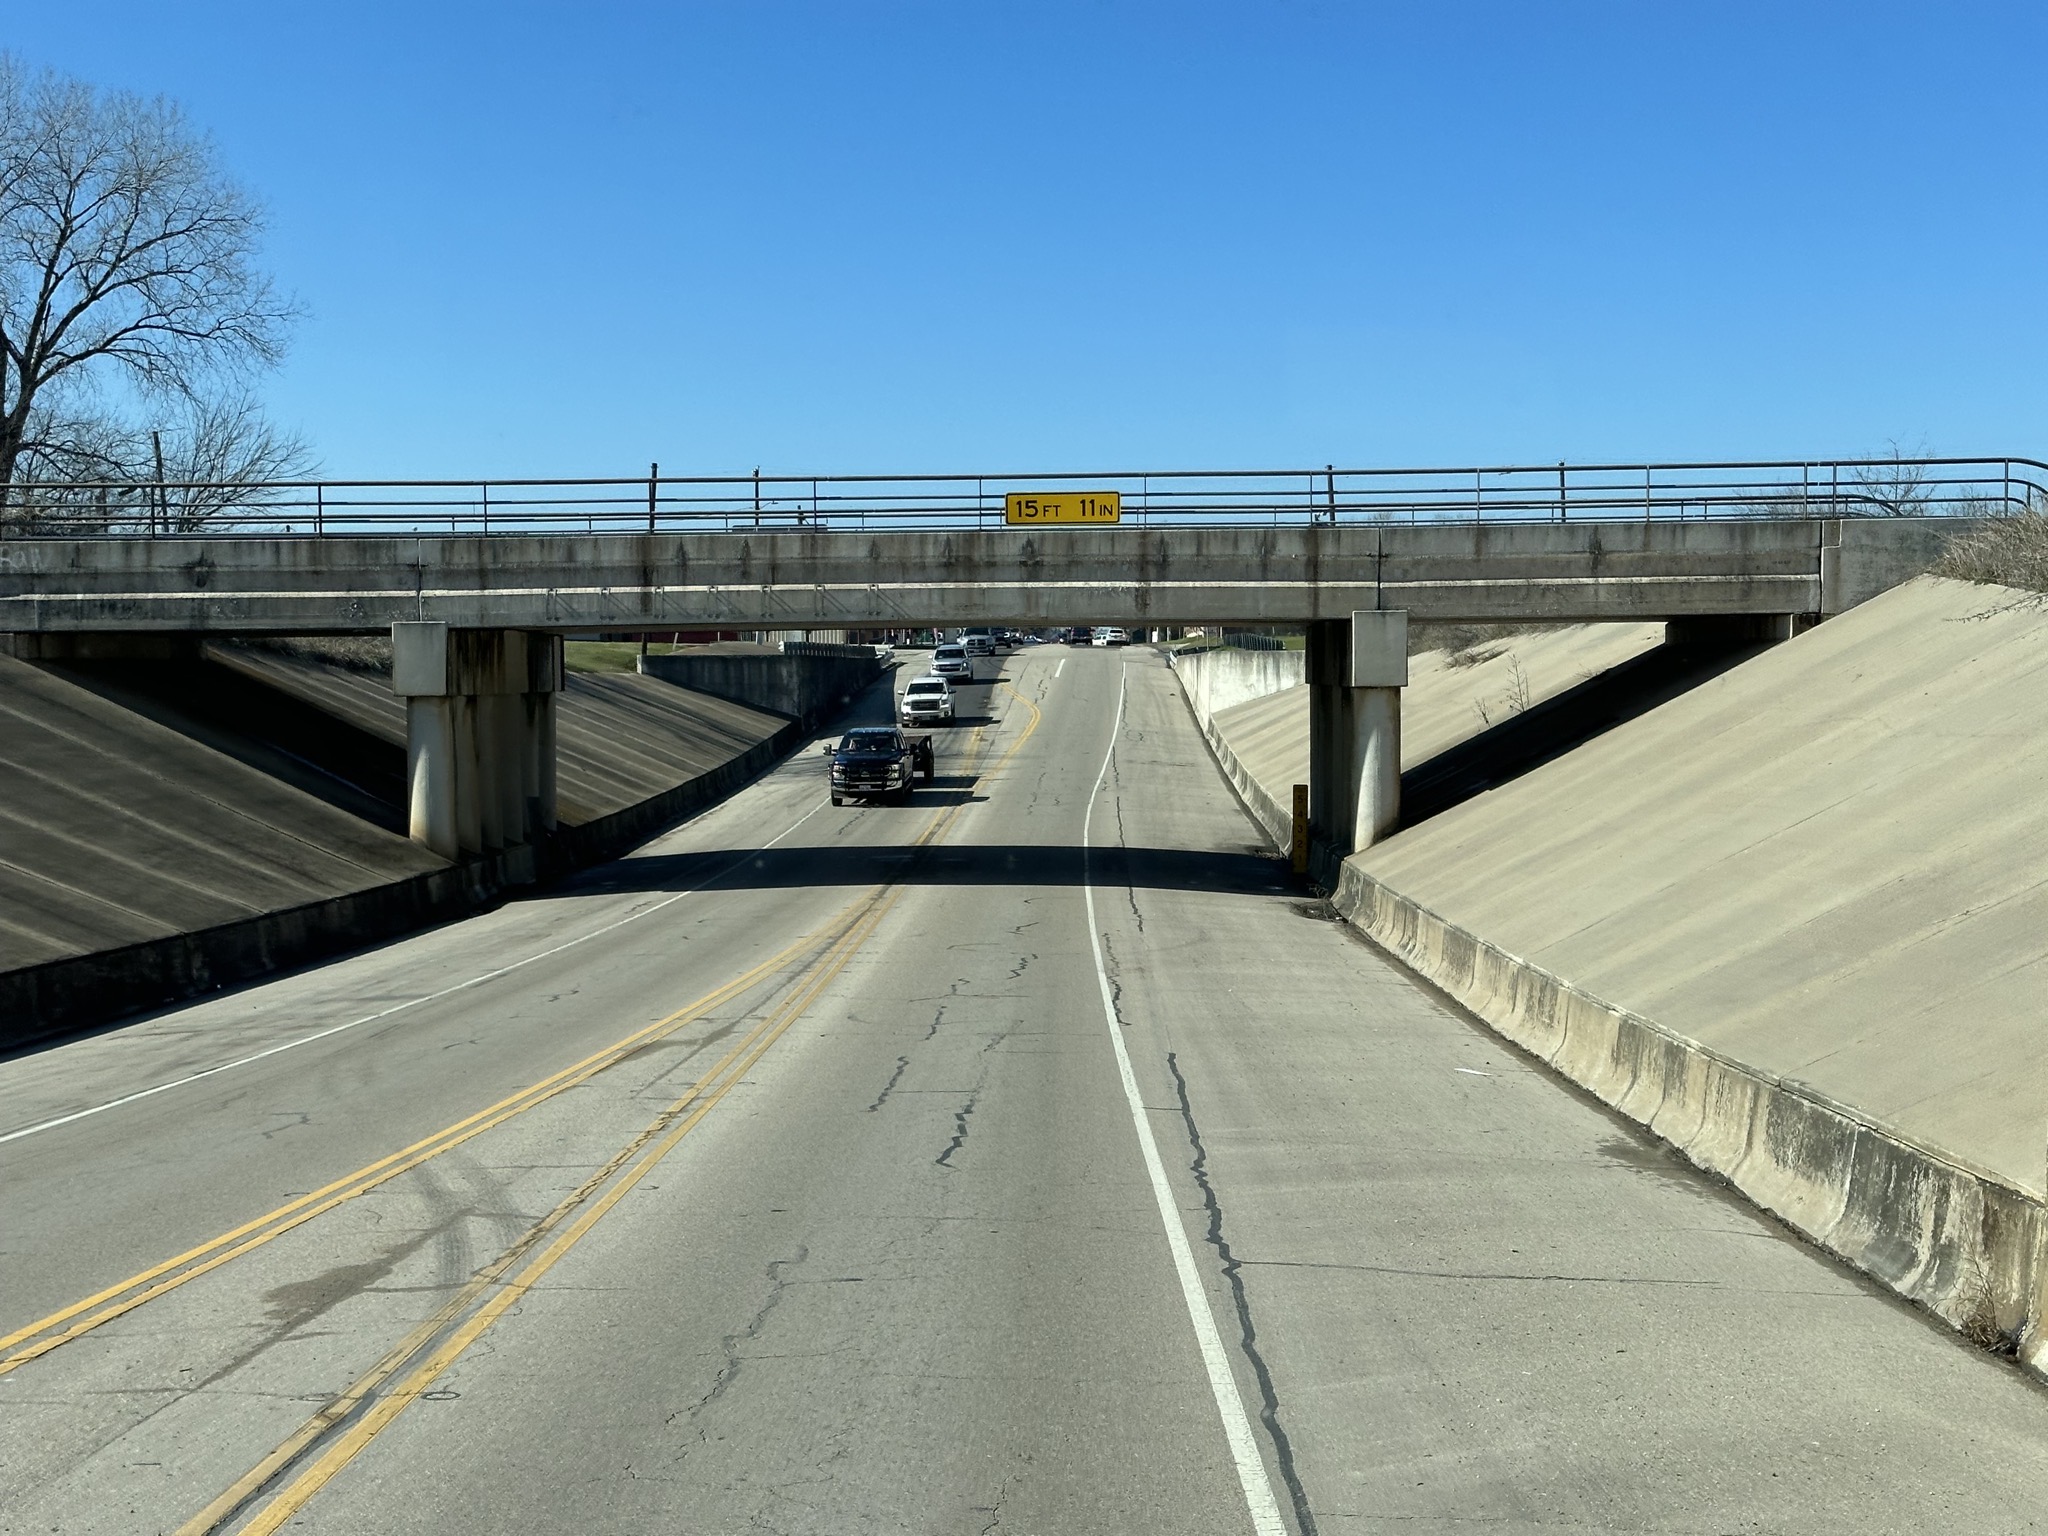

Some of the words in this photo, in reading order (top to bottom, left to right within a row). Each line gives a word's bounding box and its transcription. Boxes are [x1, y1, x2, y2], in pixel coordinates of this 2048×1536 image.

[1016, 500, 1039, 518] 15
[1043, 505, 1061, 517] FT
[1080, 499, 1095, 517] 11
[1099, 504, 1113, 517] IN
[1297, 795, 1303, 804] 5
[1297, 810, 1303, 818] 4
[1297, 825, 1303, 833] 3
[1297, 840, 1303, 848] 2
